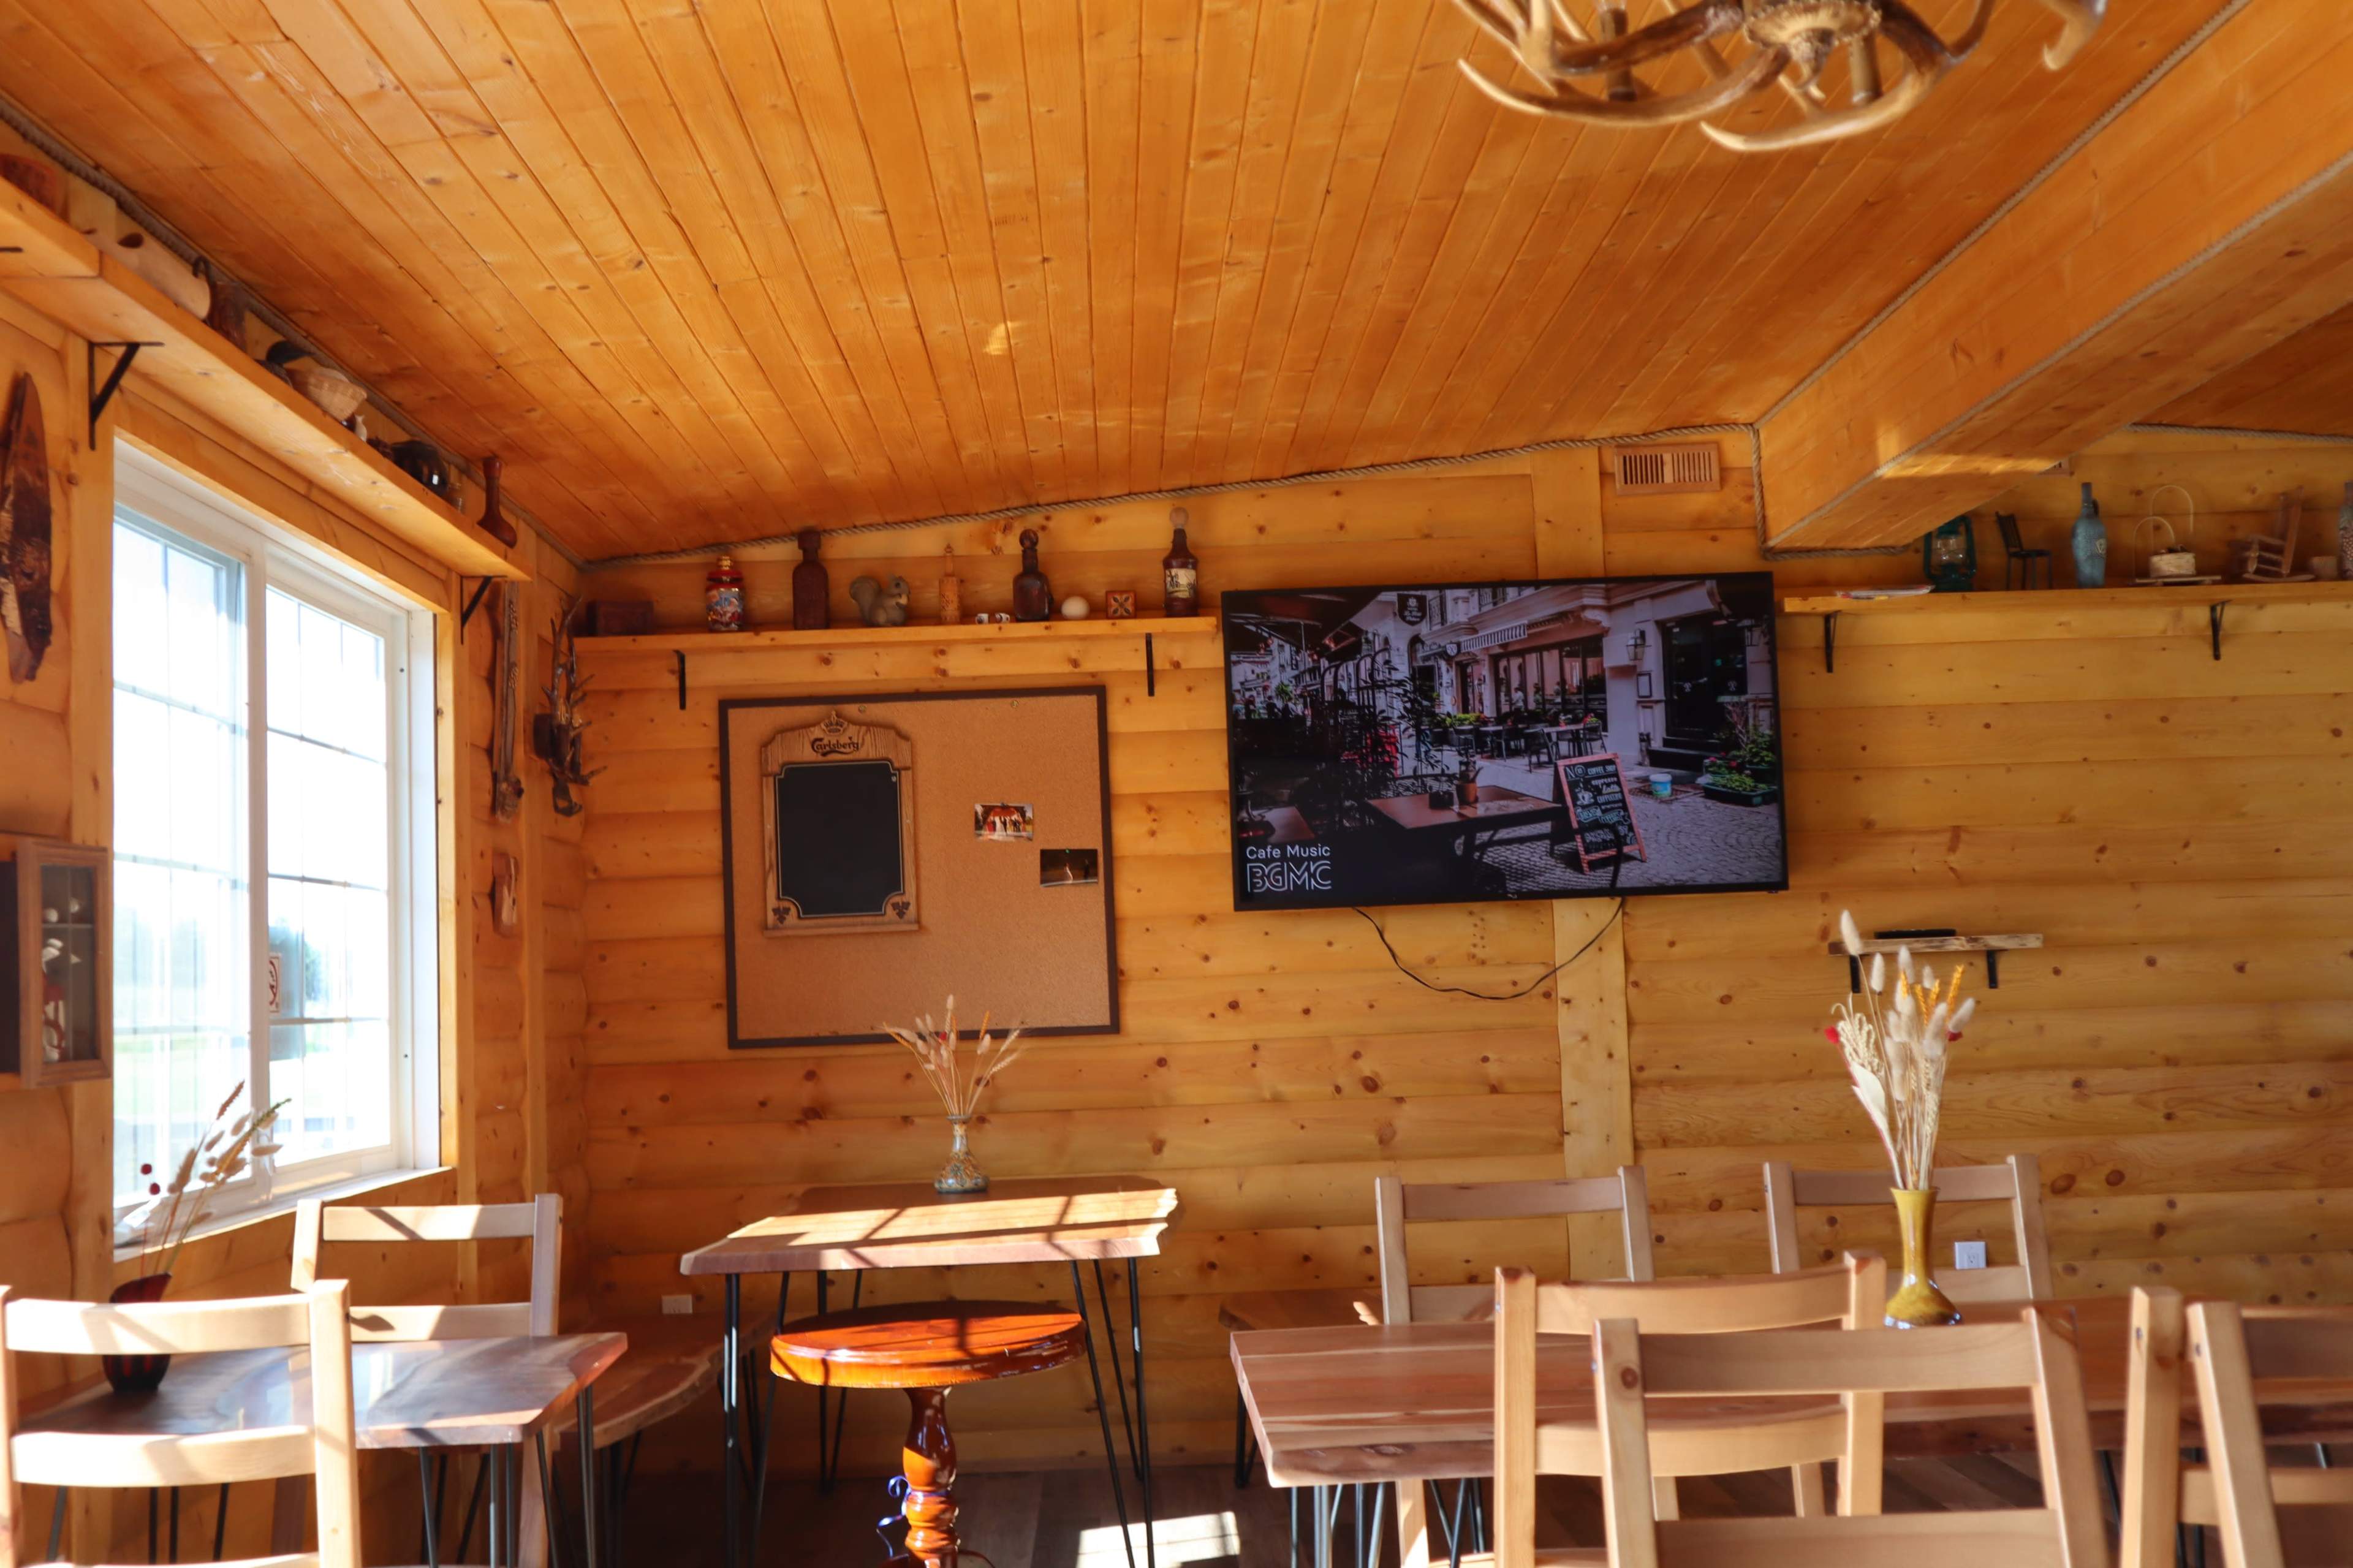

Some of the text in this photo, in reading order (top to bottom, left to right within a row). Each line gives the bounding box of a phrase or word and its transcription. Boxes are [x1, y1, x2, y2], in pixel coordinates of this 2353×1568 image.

[811, 737, 859, 757] Carlsberg
[1246, 843, 1330, 859] Cafe Music
[1247, 860, 1332, 892] BGMC
